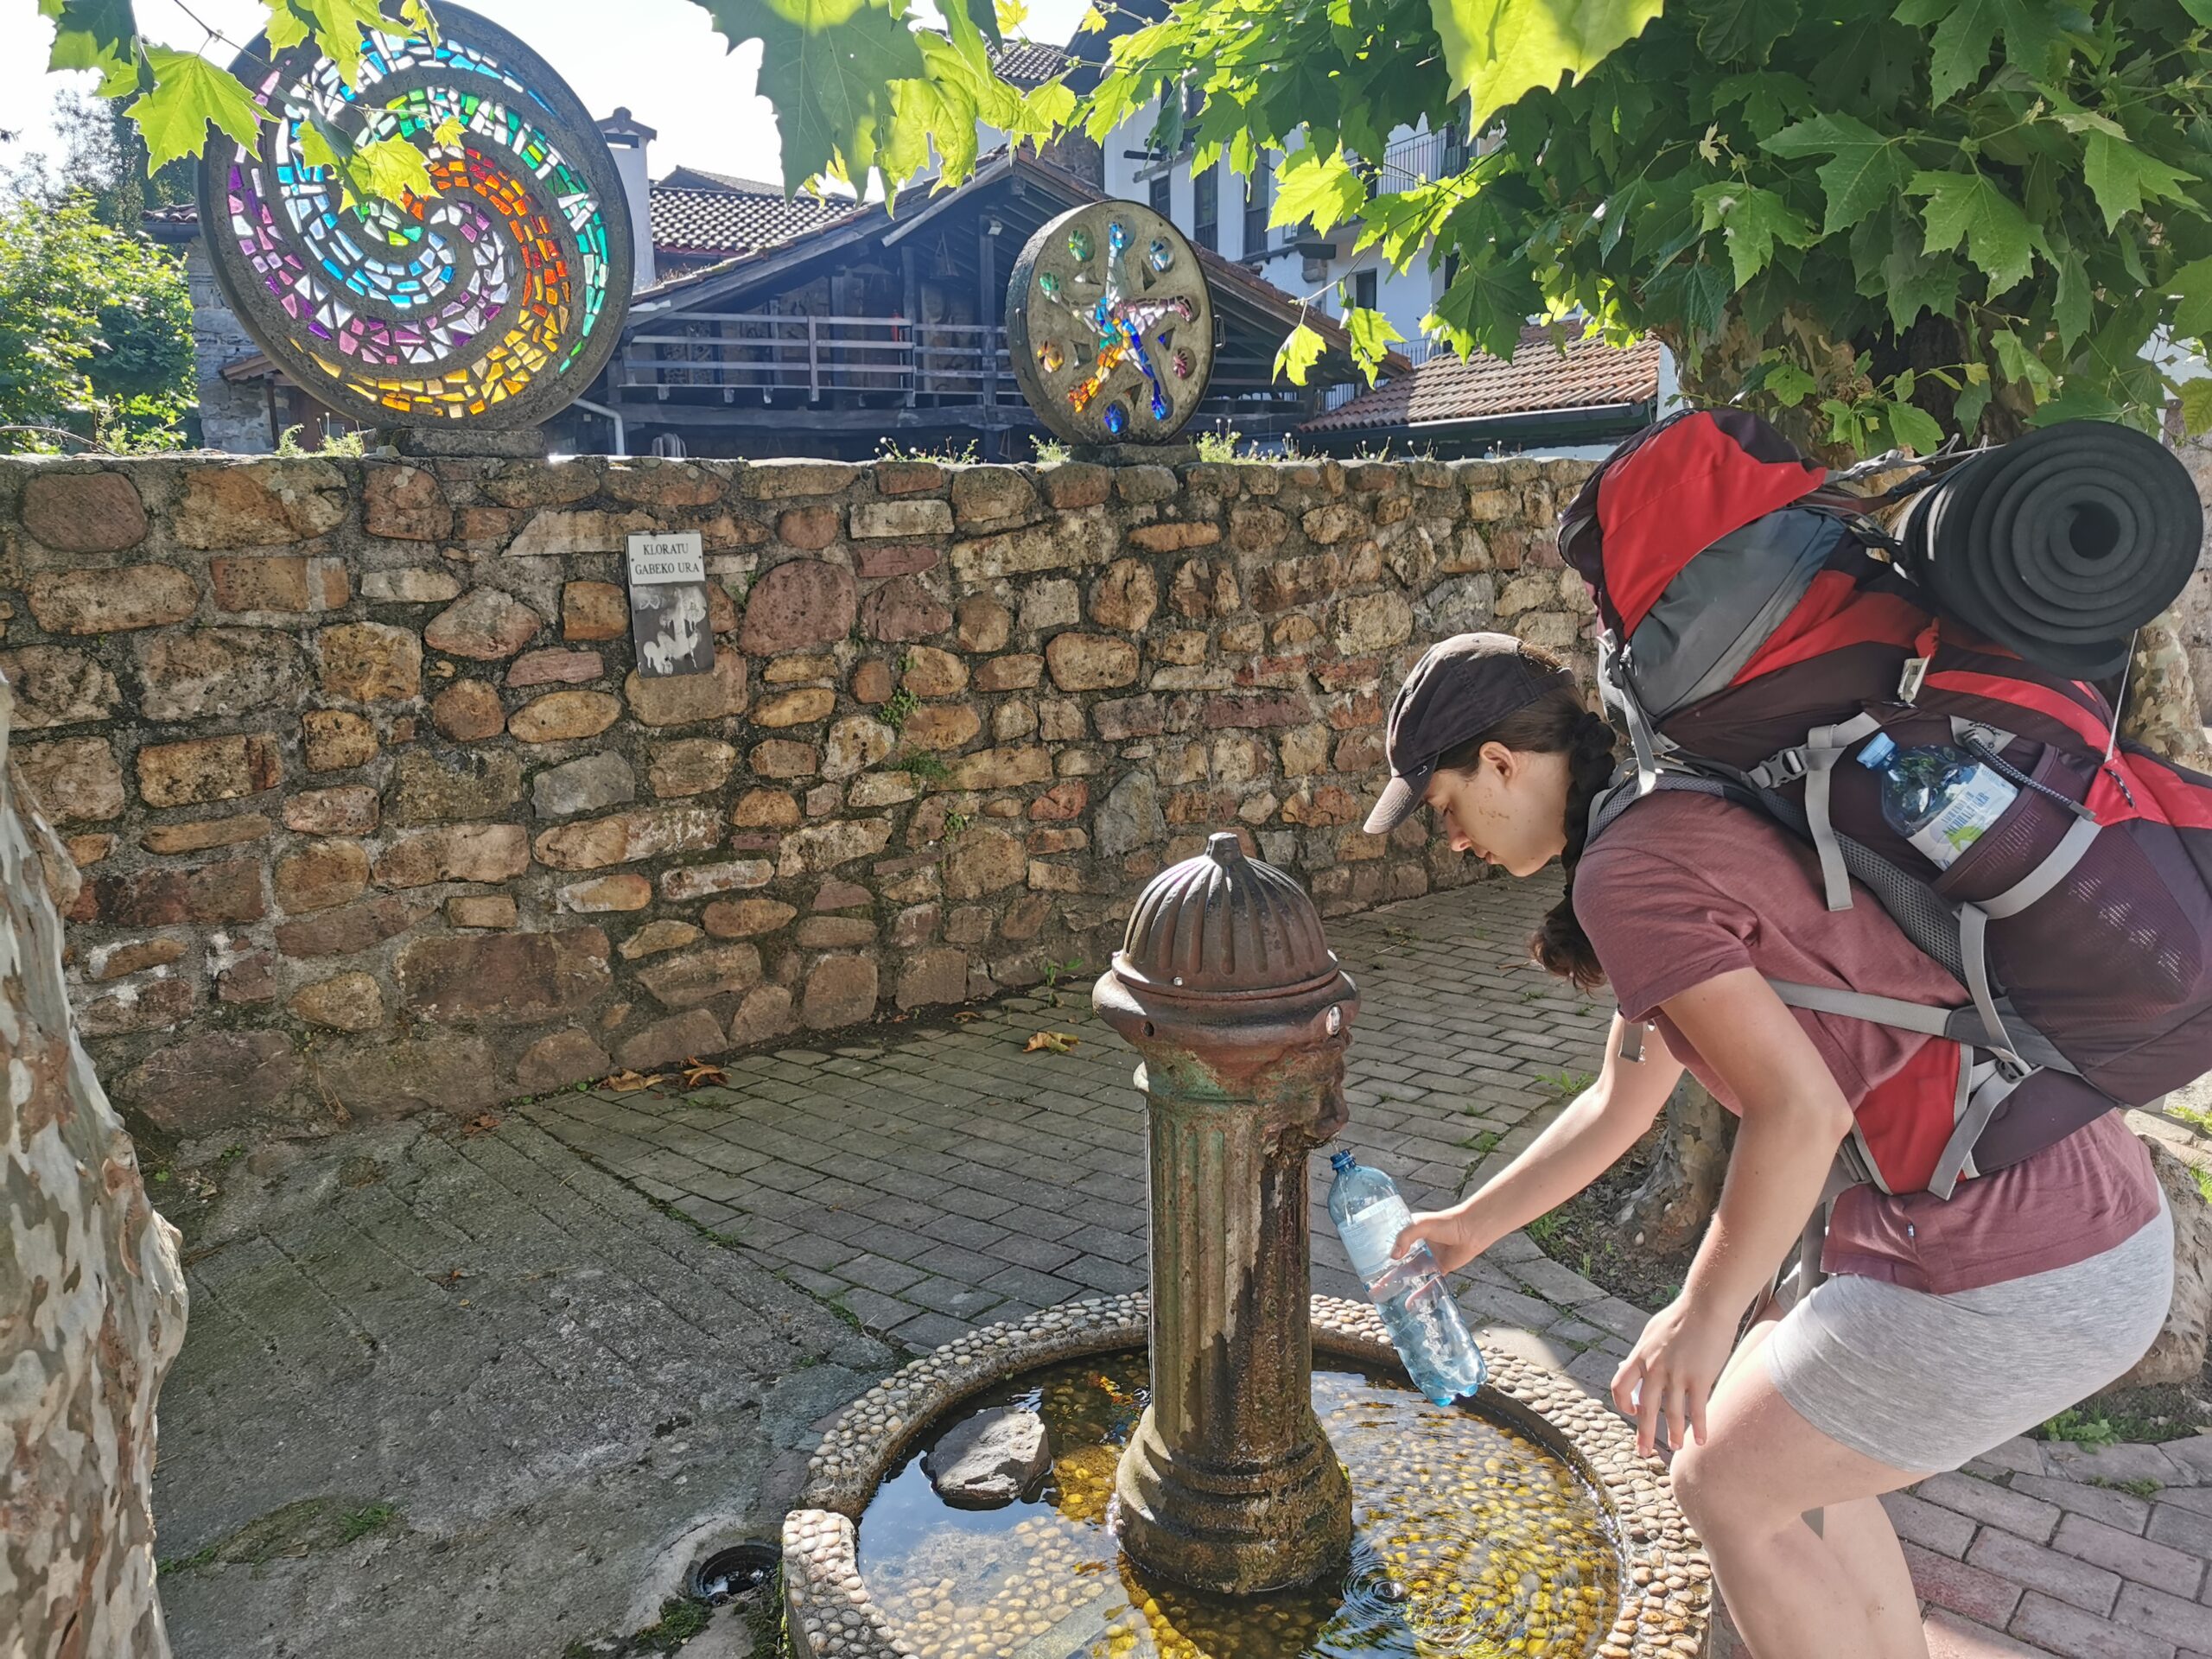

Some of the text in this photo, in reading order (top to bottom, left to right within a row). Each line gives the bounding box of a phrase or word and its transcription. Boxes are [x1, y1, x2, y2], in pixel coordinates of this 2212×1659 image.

[643, 543, 689, 555] KLORATU
[635, 562, 699, 575] GABEKO URA
